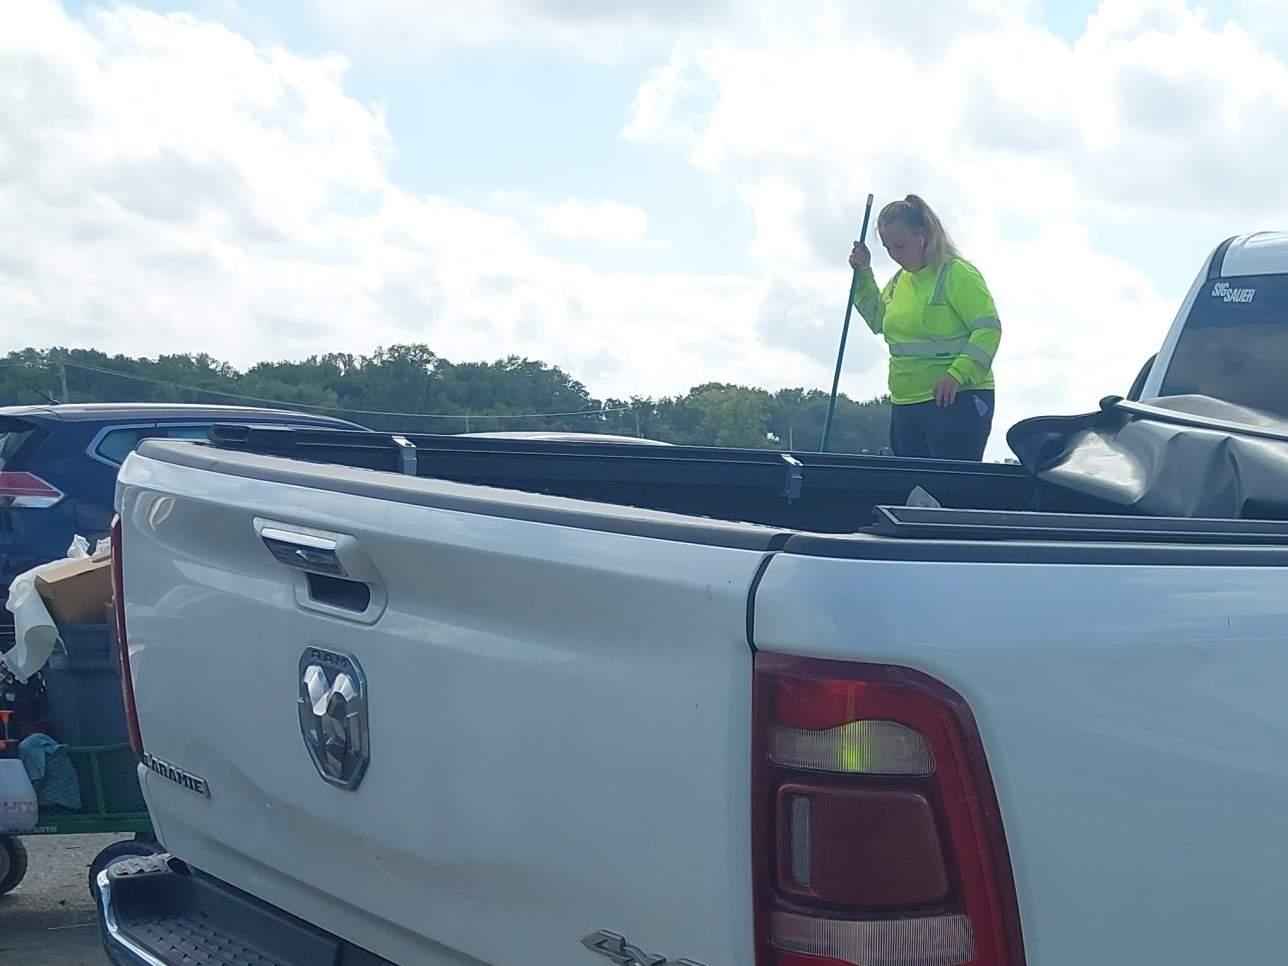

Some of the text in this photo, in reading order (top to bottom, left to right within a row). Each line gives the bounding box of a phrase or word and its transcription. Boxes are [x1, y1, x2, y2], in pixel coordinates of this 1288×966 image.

[1212, 282, 1256, 303] SIG SAUER
[143, 752, 208, 796] LARAMIE
